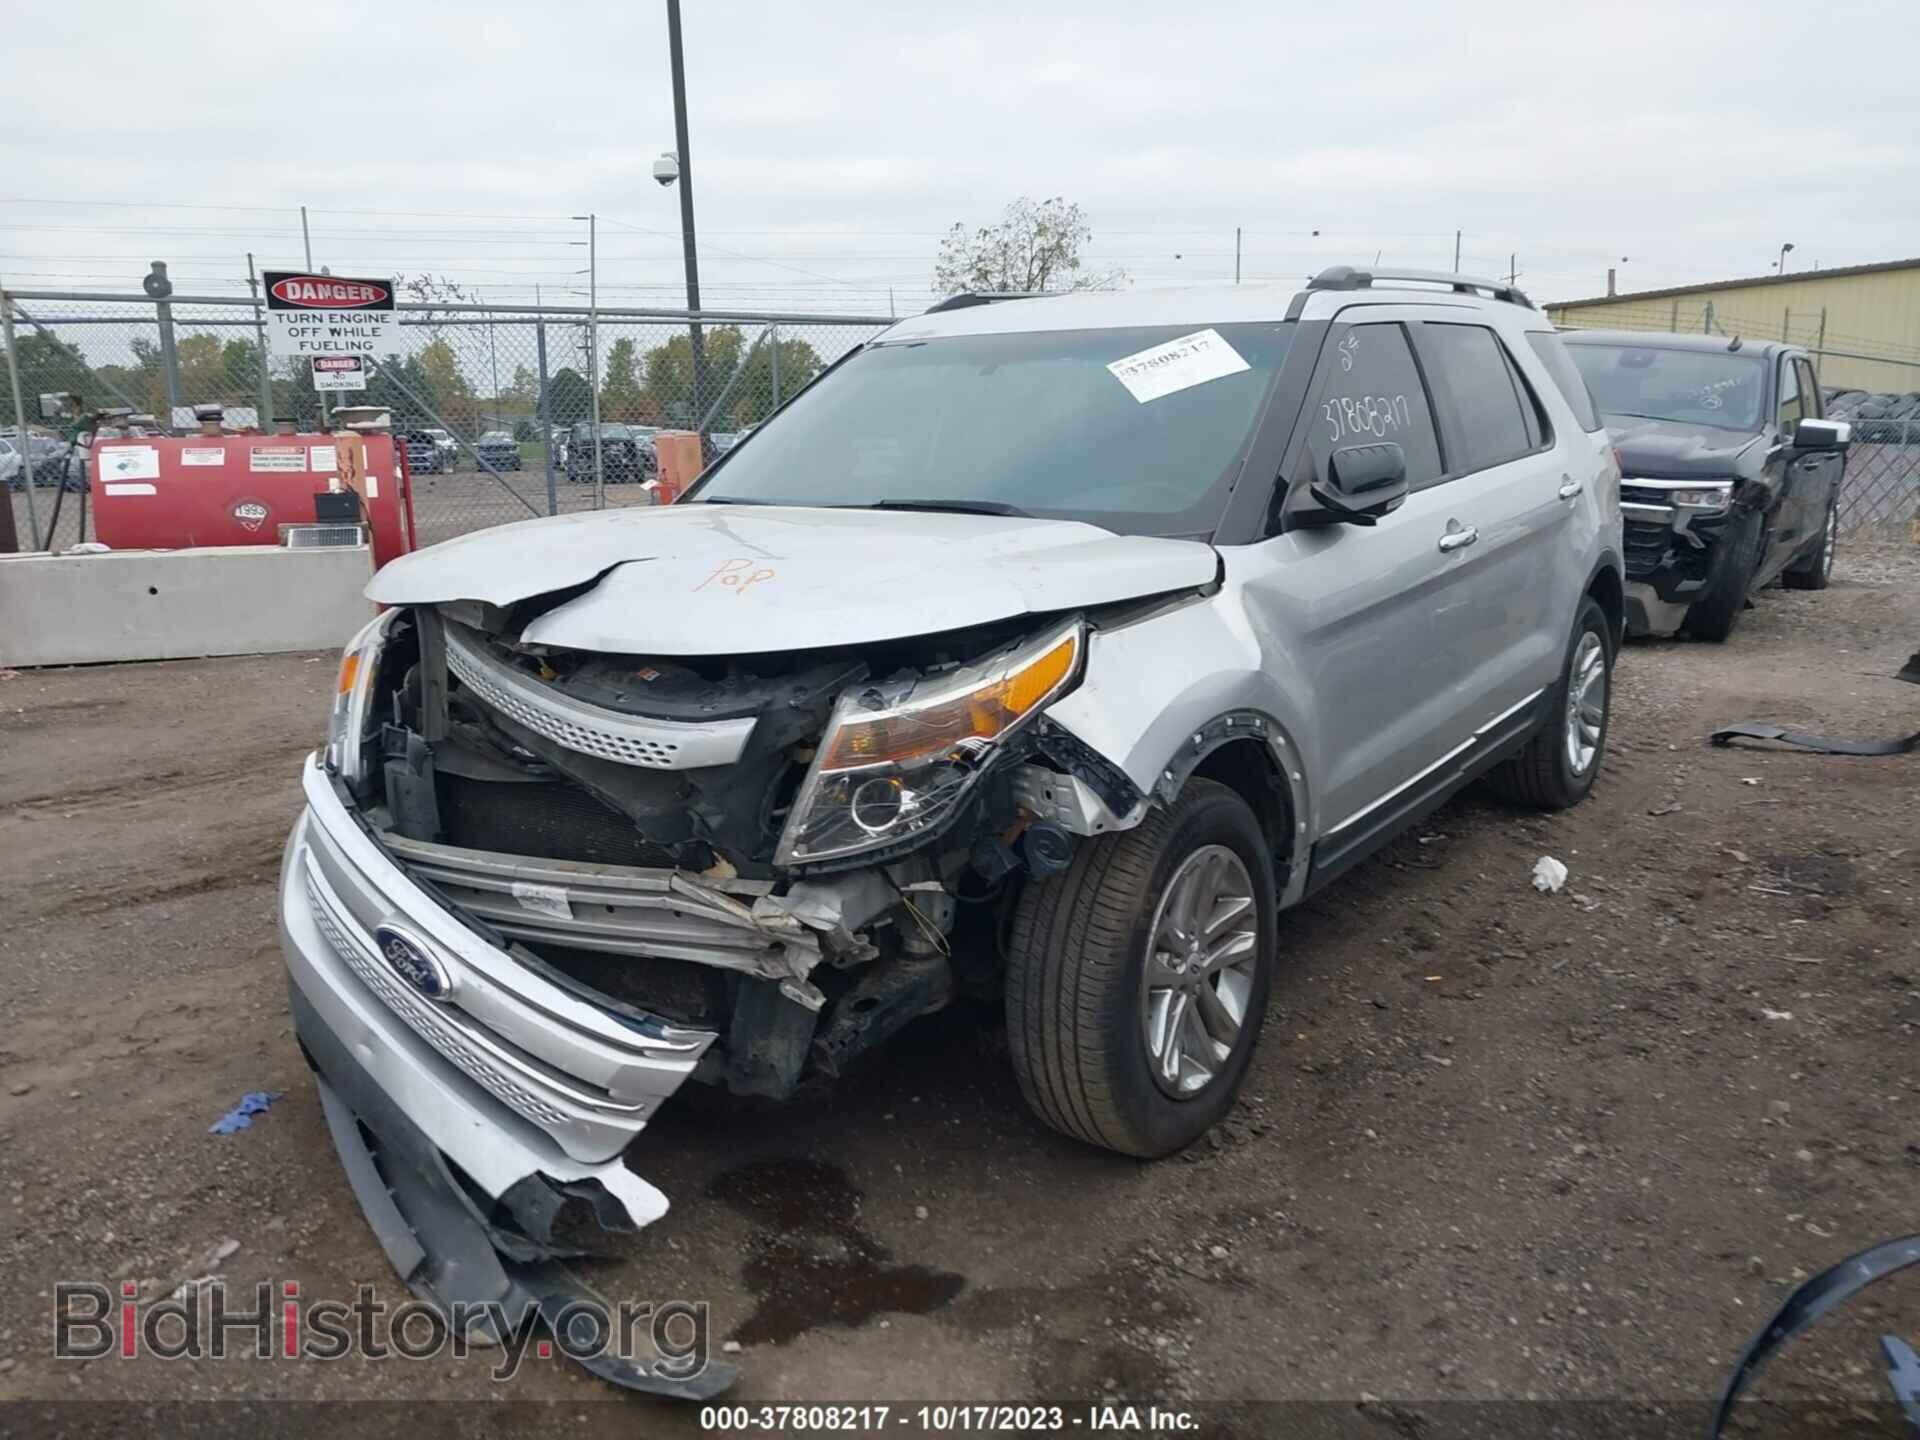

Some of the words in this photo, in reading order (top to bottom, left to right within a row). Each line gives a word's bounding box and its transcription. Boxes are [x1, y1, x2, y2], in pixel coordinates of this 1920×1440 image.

[285, 282, 376, 301] DANGER
[275, 313, 324, 324] TURN
[329, 313, 391, 324] ENGINE
[287, 327, 322, 338] OFF
[328, 327, 382, 337] WHILE
[299, 340, 374, 351] FUELING
[385, 937, 430, 984] Ford
